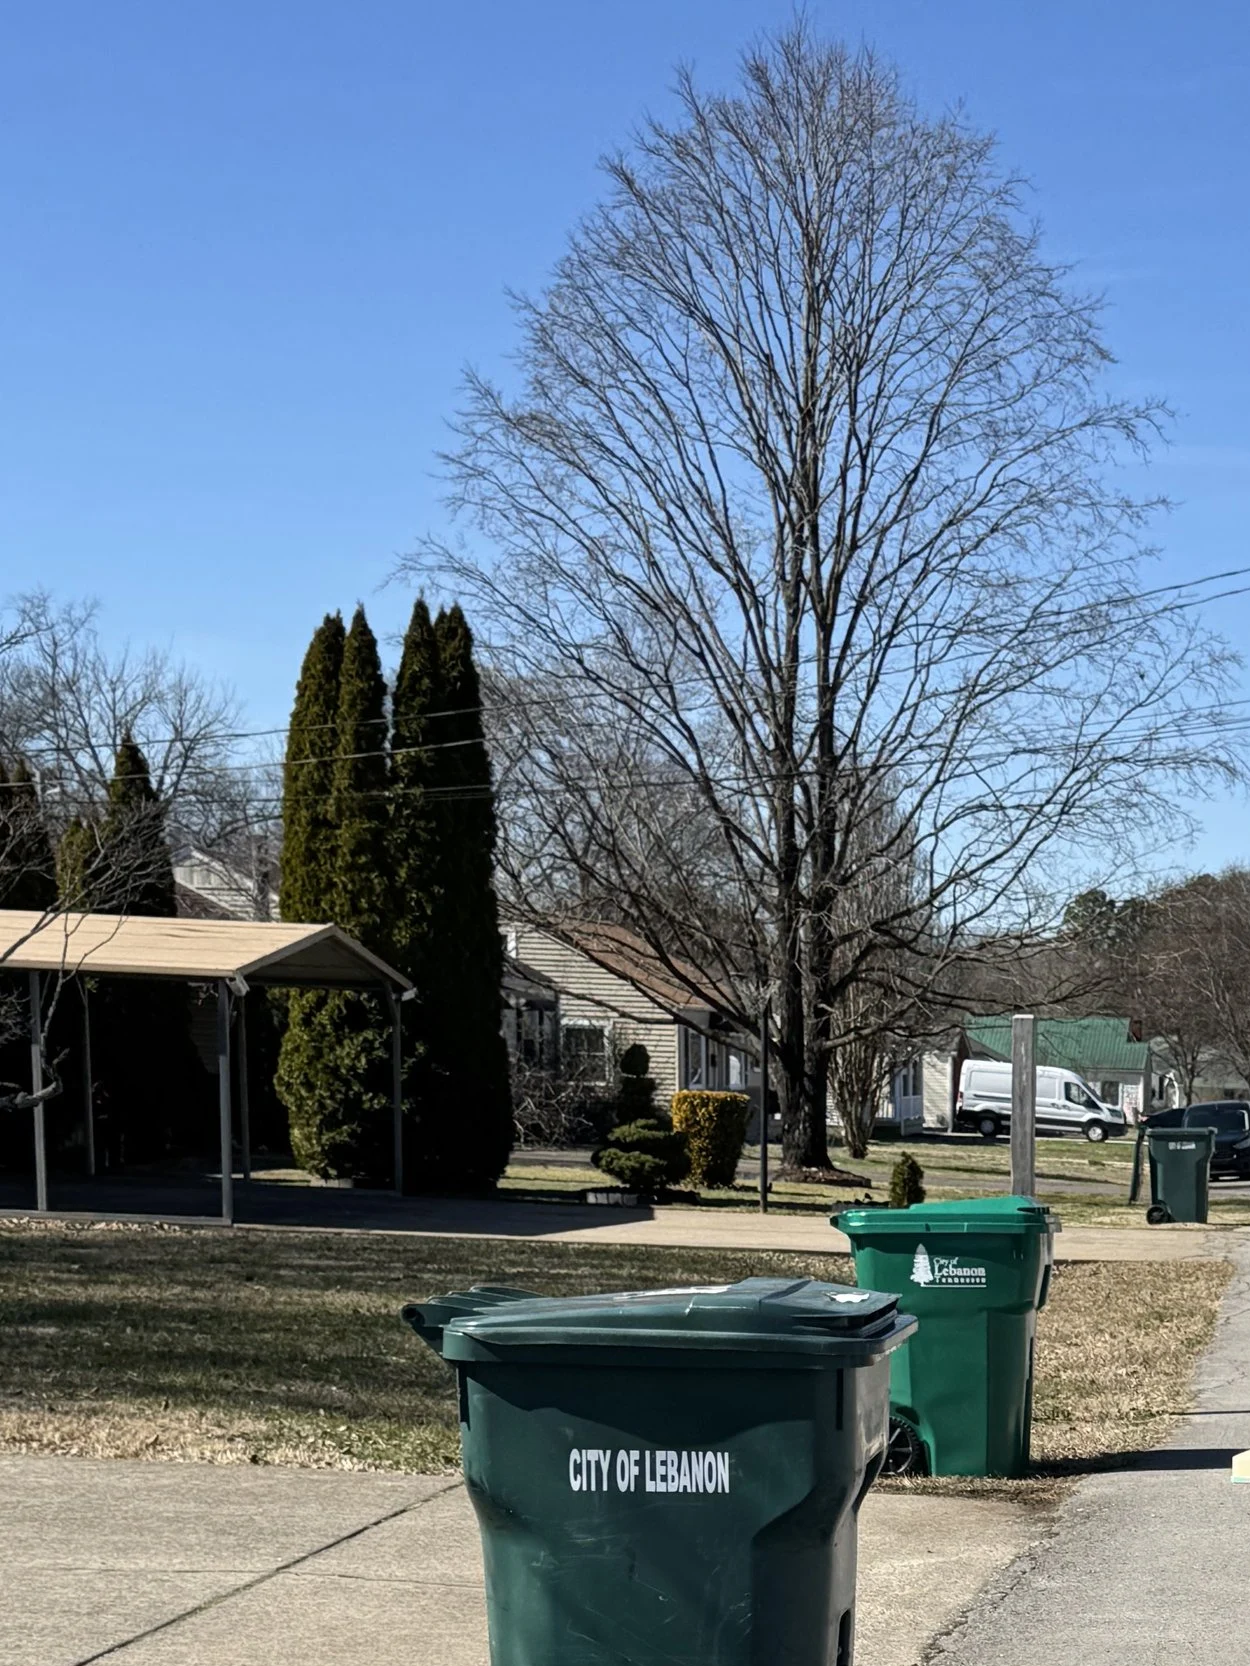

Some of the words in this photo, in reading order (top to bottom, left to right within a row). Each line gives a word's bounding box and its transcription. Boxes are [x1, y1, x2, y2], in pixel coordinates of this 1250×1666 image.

[934, 1262, 986, 1277] Lebanon
[569, 1448, 611, 1492] CITY
[616, 1449, 640, 1493] OF
[645, 1450, 730, 1494] LEBANON
